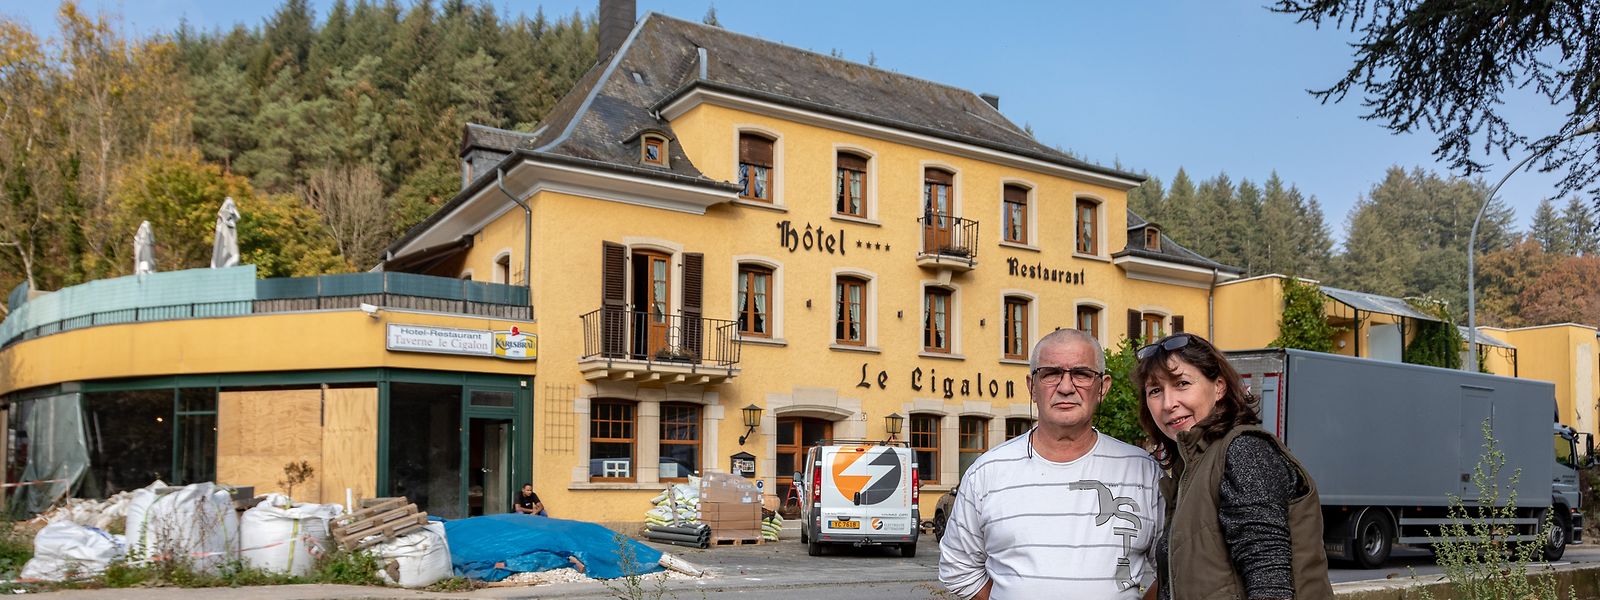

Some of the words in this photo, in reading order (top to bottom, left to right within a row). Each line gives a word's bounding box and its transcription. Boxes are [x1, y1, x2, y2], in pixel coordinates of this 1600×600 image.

[777, 220, 846, 256] Hôtel
[1007, 256, 1085, 285] Restaurant
[394, 335, 433, 346] Taverne
[439, 339, 448, 348] le
[450, 340, 488, 351] Cigalon
[400, 328, 482, 340] Hotel-Restaurant
[857, 363, 889, 390] Le
[911, 366, 1015, 399] Cigalon
